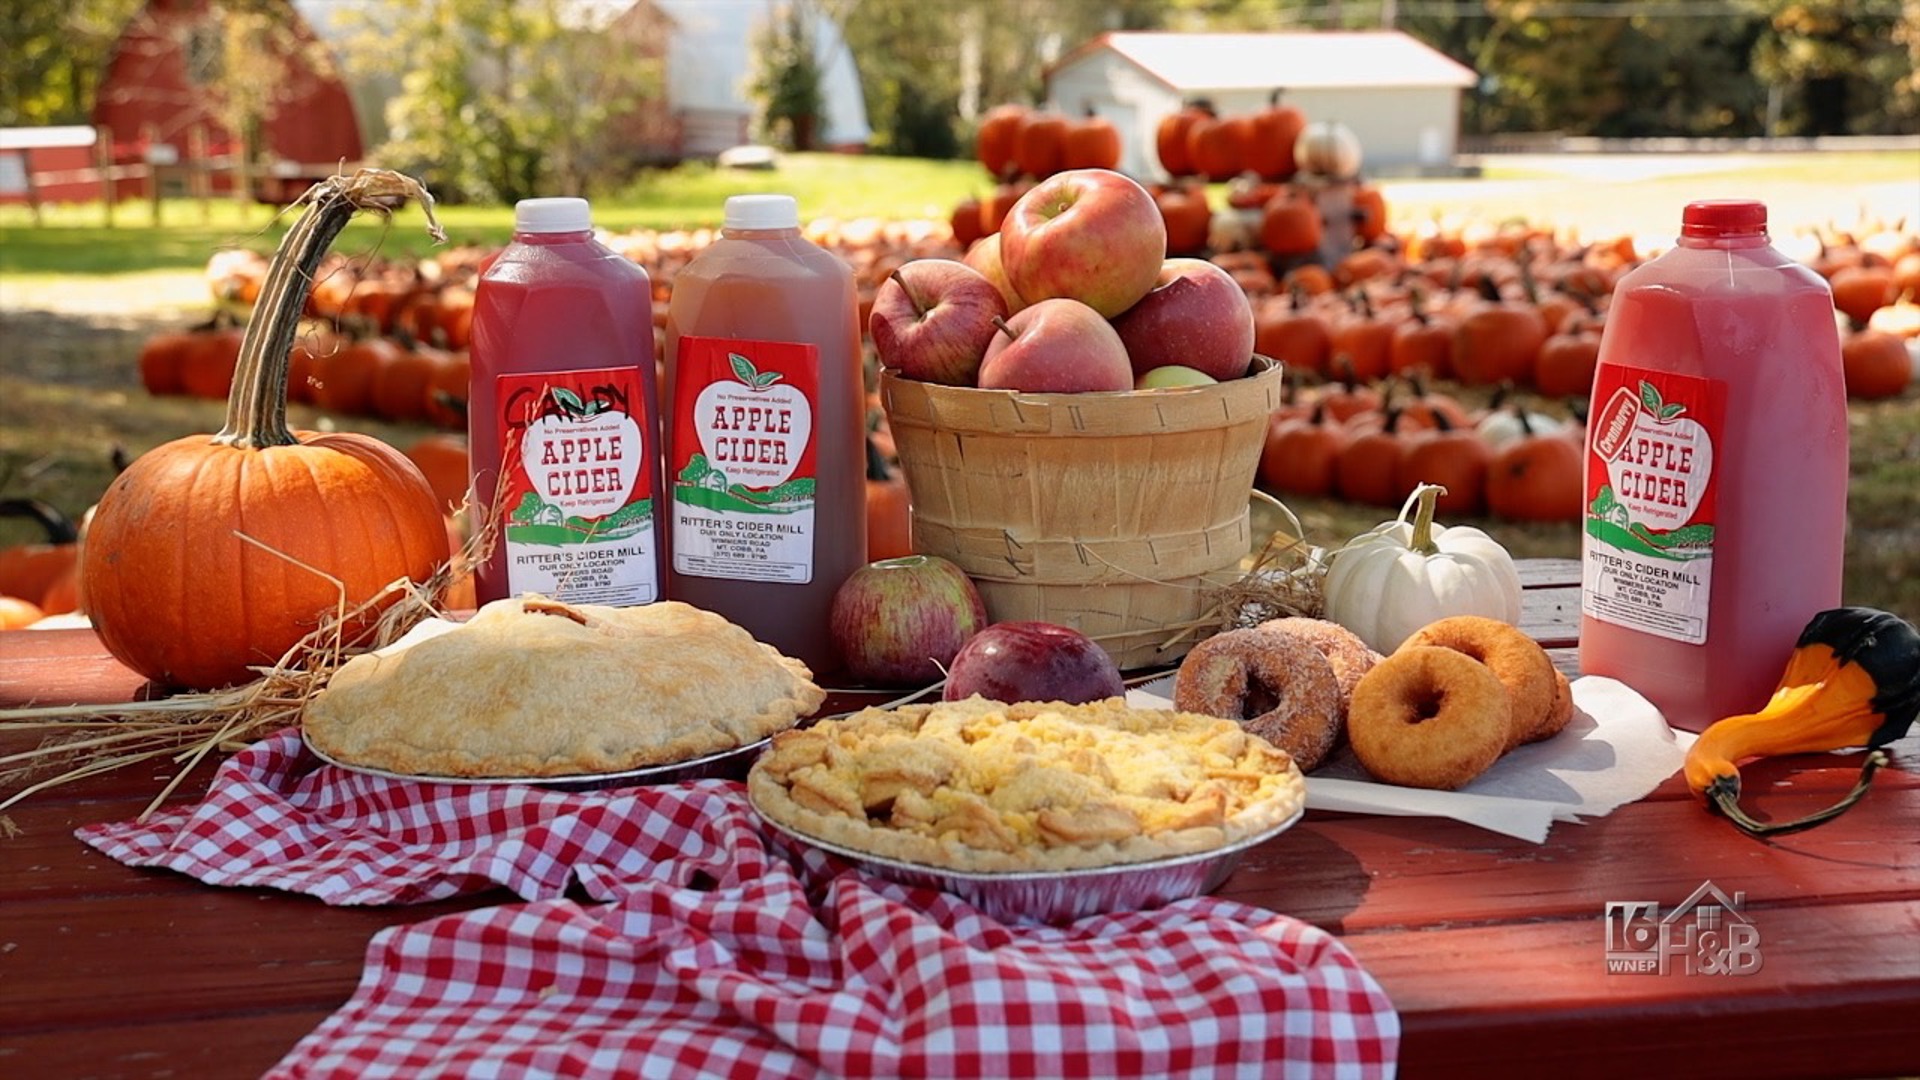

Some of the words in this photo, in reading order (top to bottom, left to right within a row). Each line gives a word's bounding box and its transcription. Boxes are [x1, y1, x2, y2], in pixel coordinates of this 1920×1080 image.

[504, 382, 630, 428] CANDY
[728, 394, 770, 403] Preservatives
[711, 405, 792, 434] APPLE
[1600, 397, 1636, 454] Cranberry
[554, 426, 598, 435] Preservatives
[600, 424, 621, 432] Added
[1674, 431, 1694, 442] Added
[541, 436, 622, 465] APPLE
[715, 437, 788, 465] CIDER
[1619, 438, 1693, 474] APPLE
[725, 466, 741, 475] Keep
[742, 468, 780, 477] Refrigerated
[547, 467, 623, 496] CIDER
[1621, 469, 1687, 508] CIDER
[560, 500, 576, 508] Keep
[577, 497, 616, 506] Refrigerated
[1628, 503, 1642, 512] Keep
[1643, 505, 1677, 519] Refrigerated
[680, 516, 733, 530] RITTER'S
[736, 521, 773, 533] CIDER
[776, 524, 805, 535] MILL
[700, 529, 718, 537] OUR
[718, 530, 742, 538] ONLY
[742, 532, 784, 541] LOCATION
[711, 538, 748, 546] WIMMERS
[517, 552, 573, 565] RITTER'S
[577, 549, 615, 561] CIDER
[617, 546, 645, 557] MILL
[538, 564, 557, 572] OUR
[583, 559, 625, 568] LOCATION
[591, 567, 614, 575] ROAD
[1589, 551, 1633, 571] RITTER'S
[1635, 563, 1670, 579] CIDER
[1672, 571, 1701, 586] MILL
[1603, 567, 1618, 576] OUR
[1619, 570, 1639, 580] ONLY
[1640, 575, 1679, 590] LOCATION
[1613, 577, 1645, 591] WIMMERS
[1646, 585, 1666, 595] ROAD
